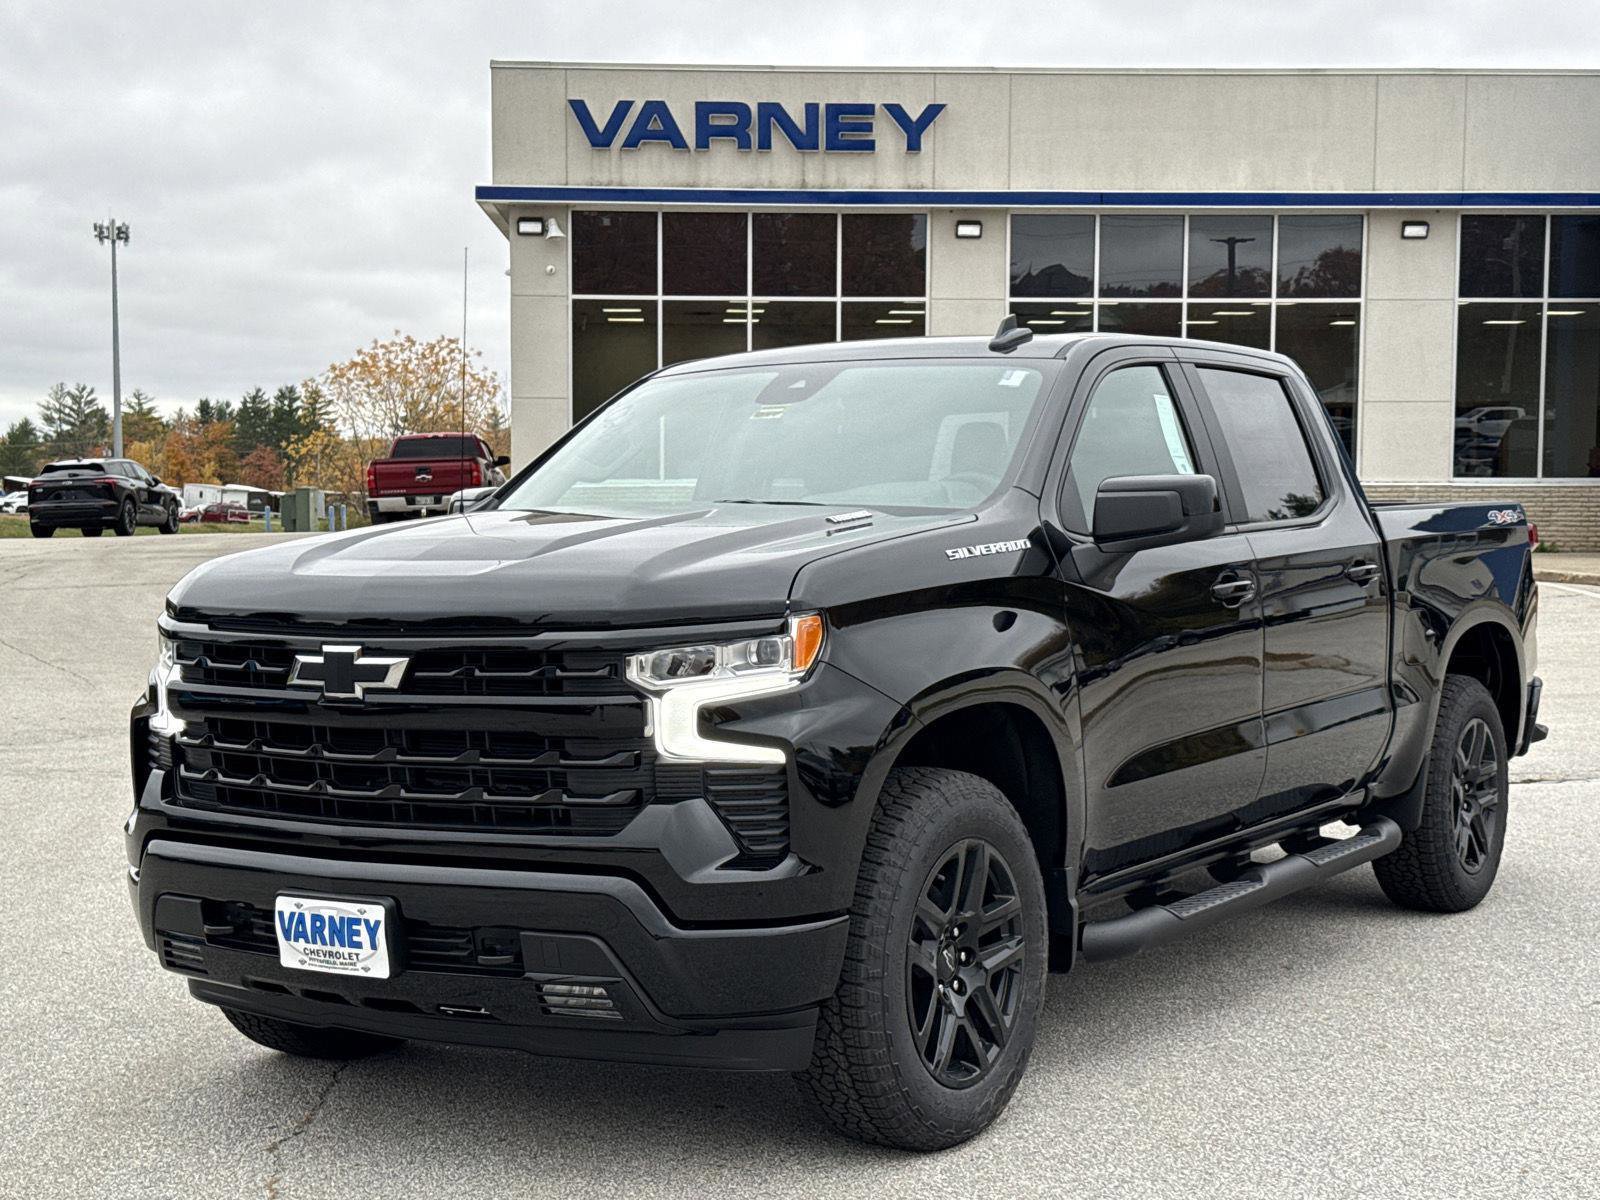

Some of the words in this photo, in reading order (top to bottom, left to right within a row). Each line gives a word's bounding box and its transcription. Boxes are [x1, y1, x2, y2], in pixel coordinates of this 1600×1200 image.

[567, 99, 948, 153] VARNEY
[945, 538, 1031, 560] SILVERADO
[277, 910, 381, 951] VARNEY
[303, 947, 360, 961] CHEVROLET
